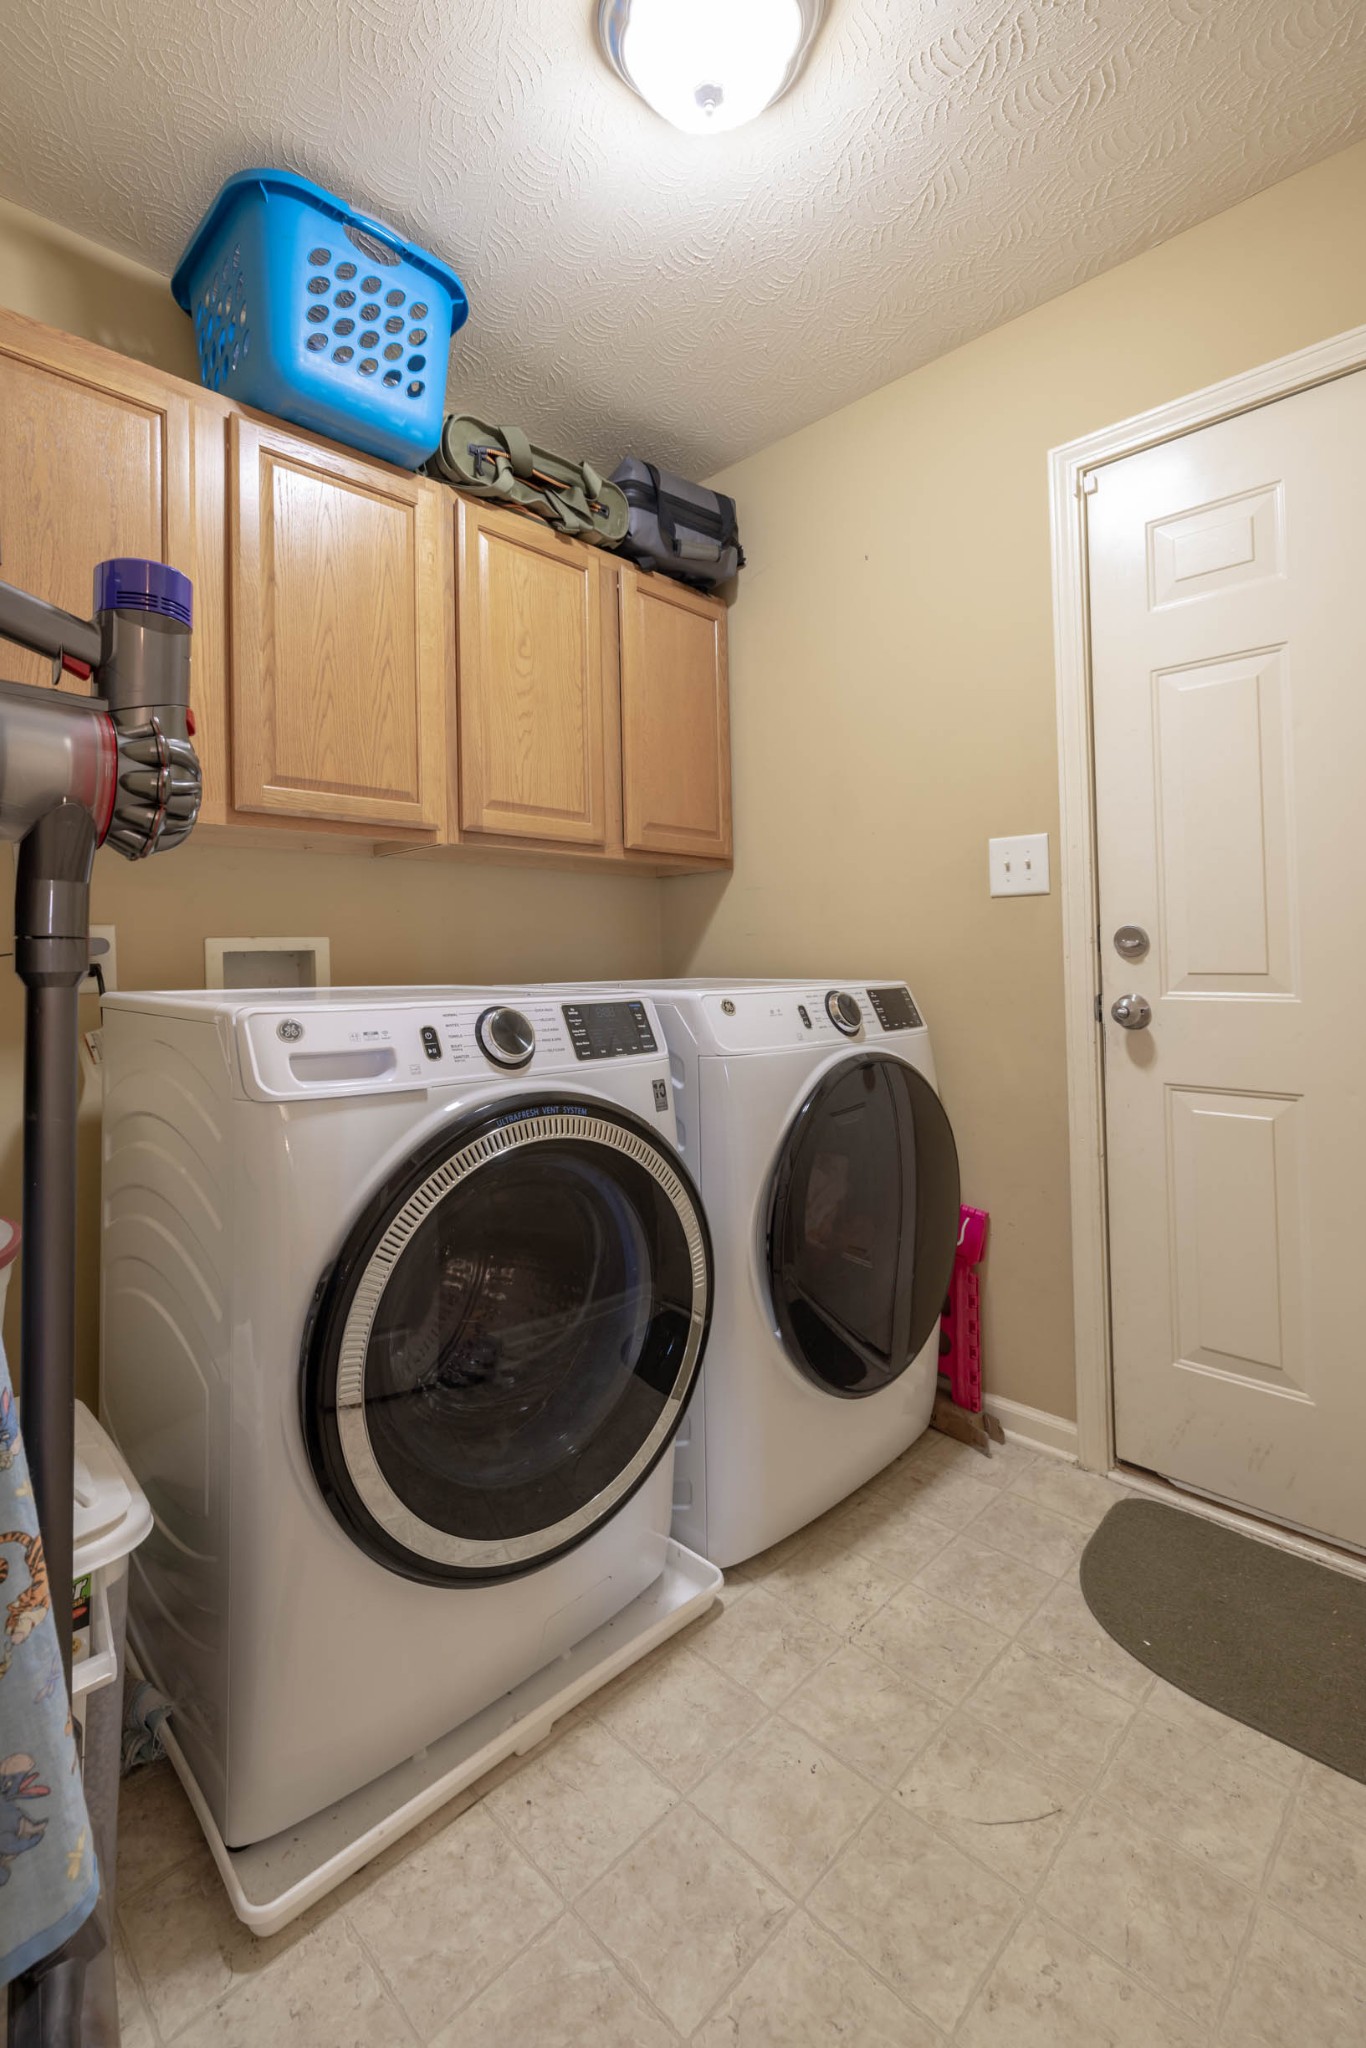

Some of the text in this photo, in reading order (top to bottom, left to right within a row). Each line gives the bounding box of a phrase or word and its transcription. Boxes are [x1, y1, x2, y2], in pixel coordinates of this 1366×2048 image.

[496, 1105, 588, 1128] ULTRAFRESH VENT SYSTEM
